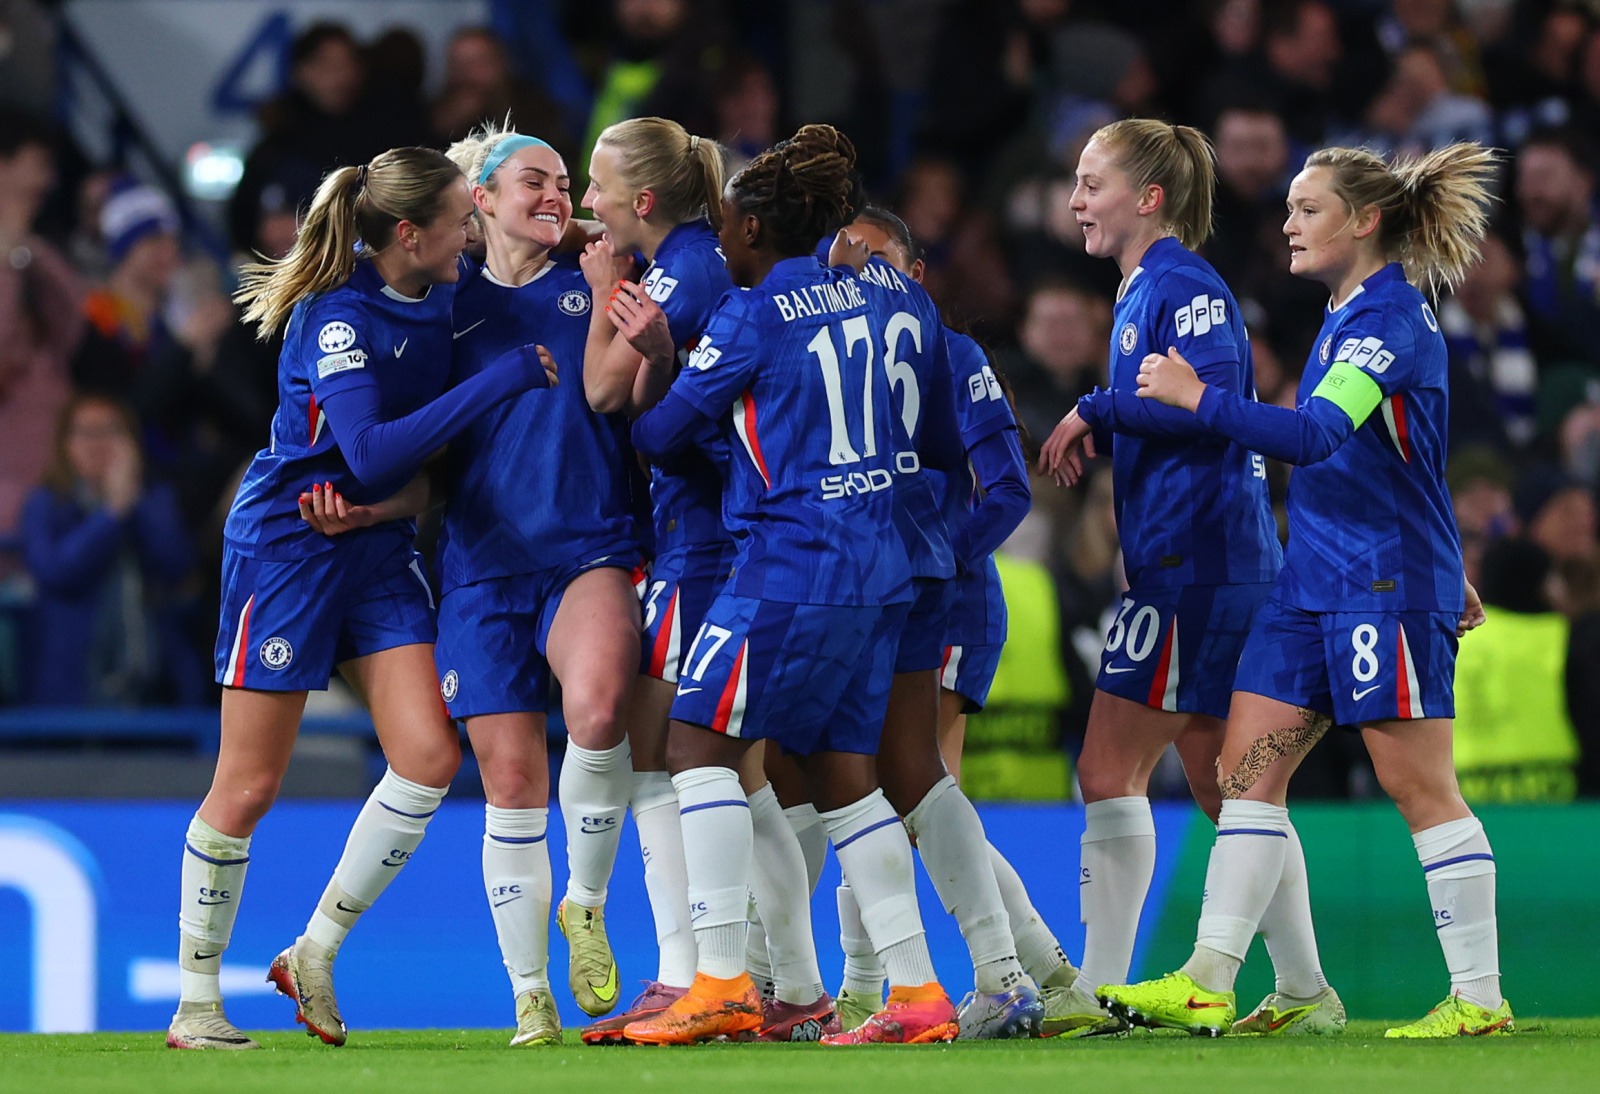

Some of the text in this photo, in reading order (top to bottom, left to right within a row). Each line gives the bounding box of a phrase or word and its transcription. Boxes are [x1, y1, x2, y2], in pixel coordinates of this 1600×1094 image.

[859, 262, 908, 293] RMA
[772, 277, 866, 322] BALTIMORE
[1176, 299, 1225, 334] FPT
[1337, 340, 1392, 370] FPT
[806, 315, 877, 465] 17
[1106, 597, 1160, 662] 30
[681, 622, 732, 682] 17
[1352, 623, 1379, 682] 8
[582, 816, 616, 826] CFC
[199, 887, 231, 898] CFC
[492, 884, 522, 896] CFC
